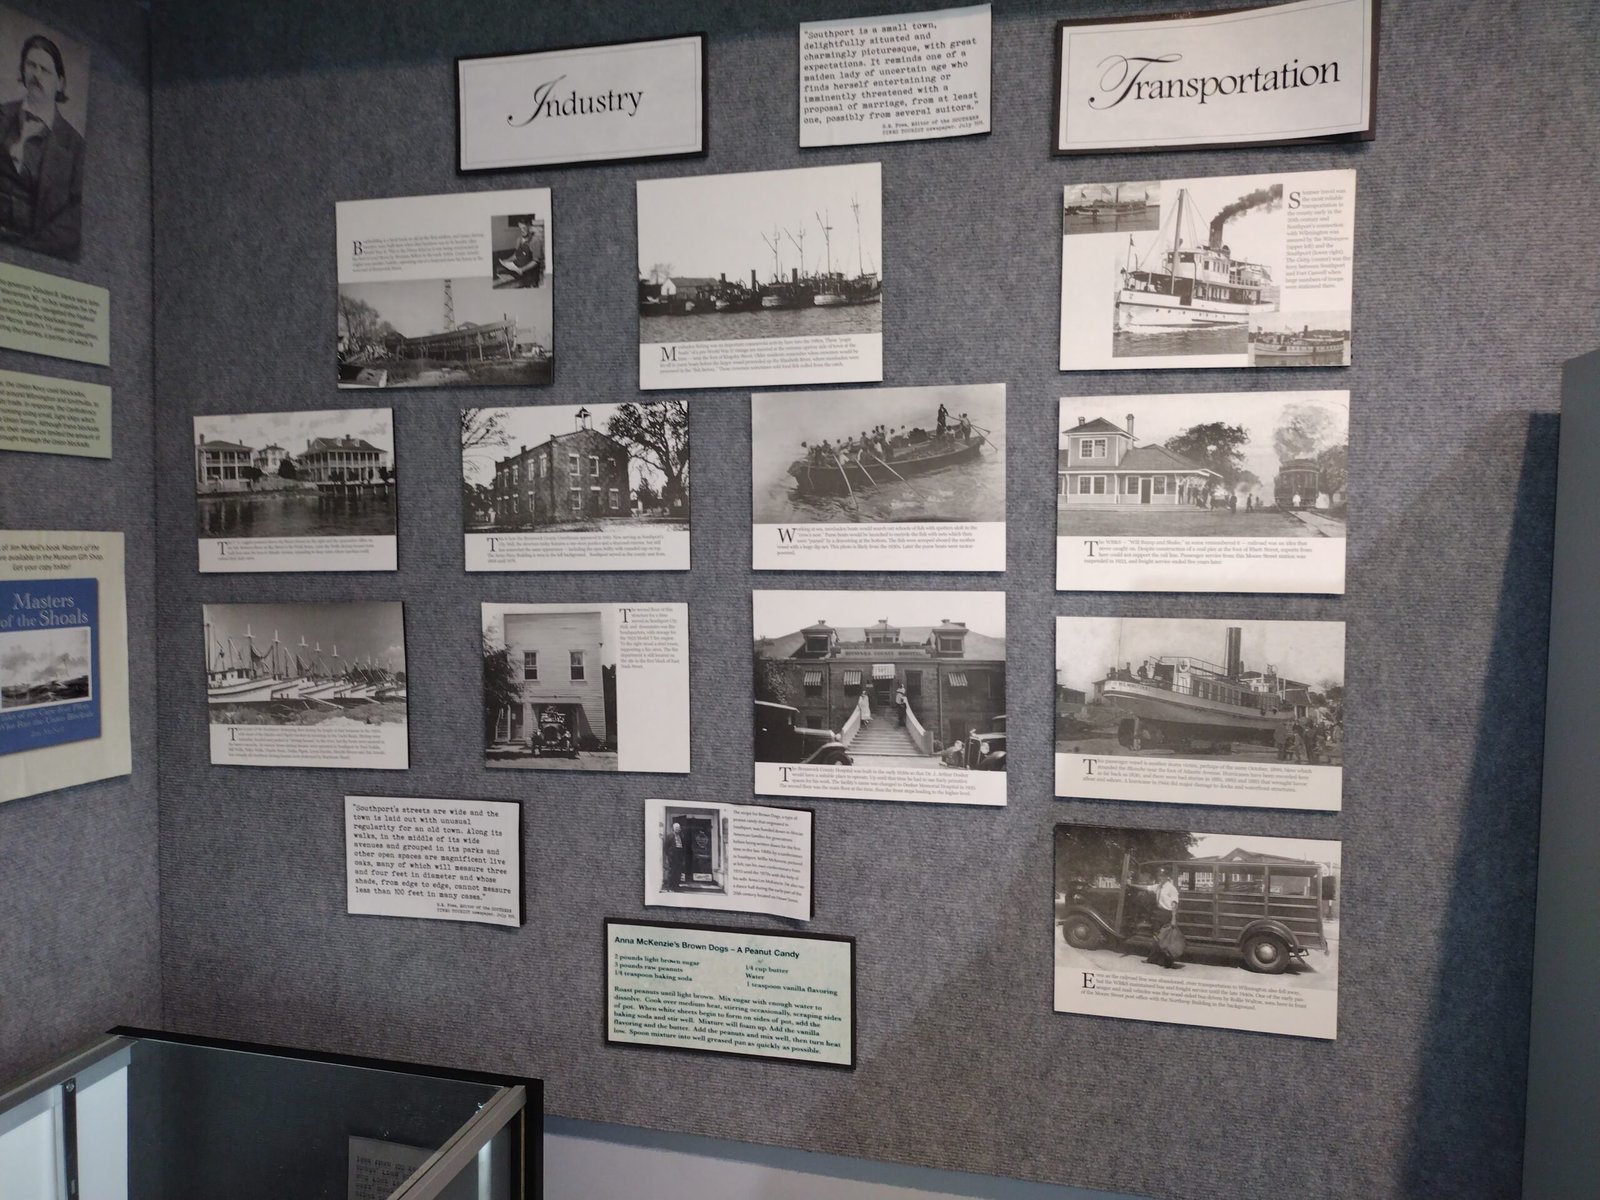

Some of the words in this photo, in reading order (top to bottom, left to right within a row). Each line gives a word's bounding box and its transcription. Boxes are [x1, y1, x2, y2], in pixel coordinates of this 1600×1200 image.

[804, 27, 854, 39] "Southport
[859, 26, 868, 34] is
[881, 23, 906, 32] small
[912, 22, 937, 30] town,
[803, 38, 865, 51] delightfully
[869, 34, 909, 44] situated
[914, 31, 930, 40] and
[803, 49, 856, 62] charmingly
[861, 44, 919, 56] picturesque,
[924, 40, 945, 50] with
[950, 37, 976, 48] great
[803, 59, 865, 72] expectations.
[871, 57, 879, 66] It
[885, 54, 921, 64] reminds
[946, 50, 956, 58] of
[803, 72, 835, 81] maiden
[840, 70, 860, 80] lady
[864, 68, 875, 76] of
[879, 64, 926, 75] uncertain
[931, 63, 946, 72] age
[951, 60, 967, 68] who
[804, 83, 829, 92] finds
[833, 80, 868, 90] herself
[873, 74, 936, 87] entertaining
[1088, 53, 1340, 110] Transportation
[507, 74, 643, 128] Industry
[803, 103, 842, 114] proposal
[847, 102, 858, 110] of
[862, 99, 906, 110] marriage,
[912, 96, 933, 104] from
[953, 91, 977, 100] least
[804, 92, 856, 104] imminently
[861, 87, 912, 98] threatened
[917, 84, 938, 93] with
[803, 116, 821, 125] one,
[826, 112, 864, 123] possibly
[869, 110, 890, 119] from
[895, 107, 930, 116] several
[13, 592, 75, 610] Masters
[0, 614, 14, 628] of
[17, 614, 37, 627] the
[39, 608, 89, 626] Shoals
[353, 823, 395, 832] regularity
[466, 827, 487, 836] Along
[353, 831, 377, 840] walks,
[402, 843, 432, 852] grouped
[462, 846, 483, 854] parks
[440, 854, 486, 863] magnificent
[487, 866, 506, 874] three
[614, 936, 634, 944] Anna
[636, 938, 679, 947] McKenzie's
[681, 941, 706, 949] Brown
[708, 944, 728, 953] Dogs
[744, 946, 771, 955] Peanut
[774, 949, 799, 959] Candy
[619, 954, 643, 962] pounds
[644, 955, 658, 963] light
[619, 962, 643, 970] pounds
[624, 971, 653, 979] teaspoon
[654, 972, 676, 981] baking
[633, 988, 659, 996] peanuts
[677, 991, 691, 999] light
[768, 1000, 792, 1008] enough
[806, 986, 837, 996] flavoring
